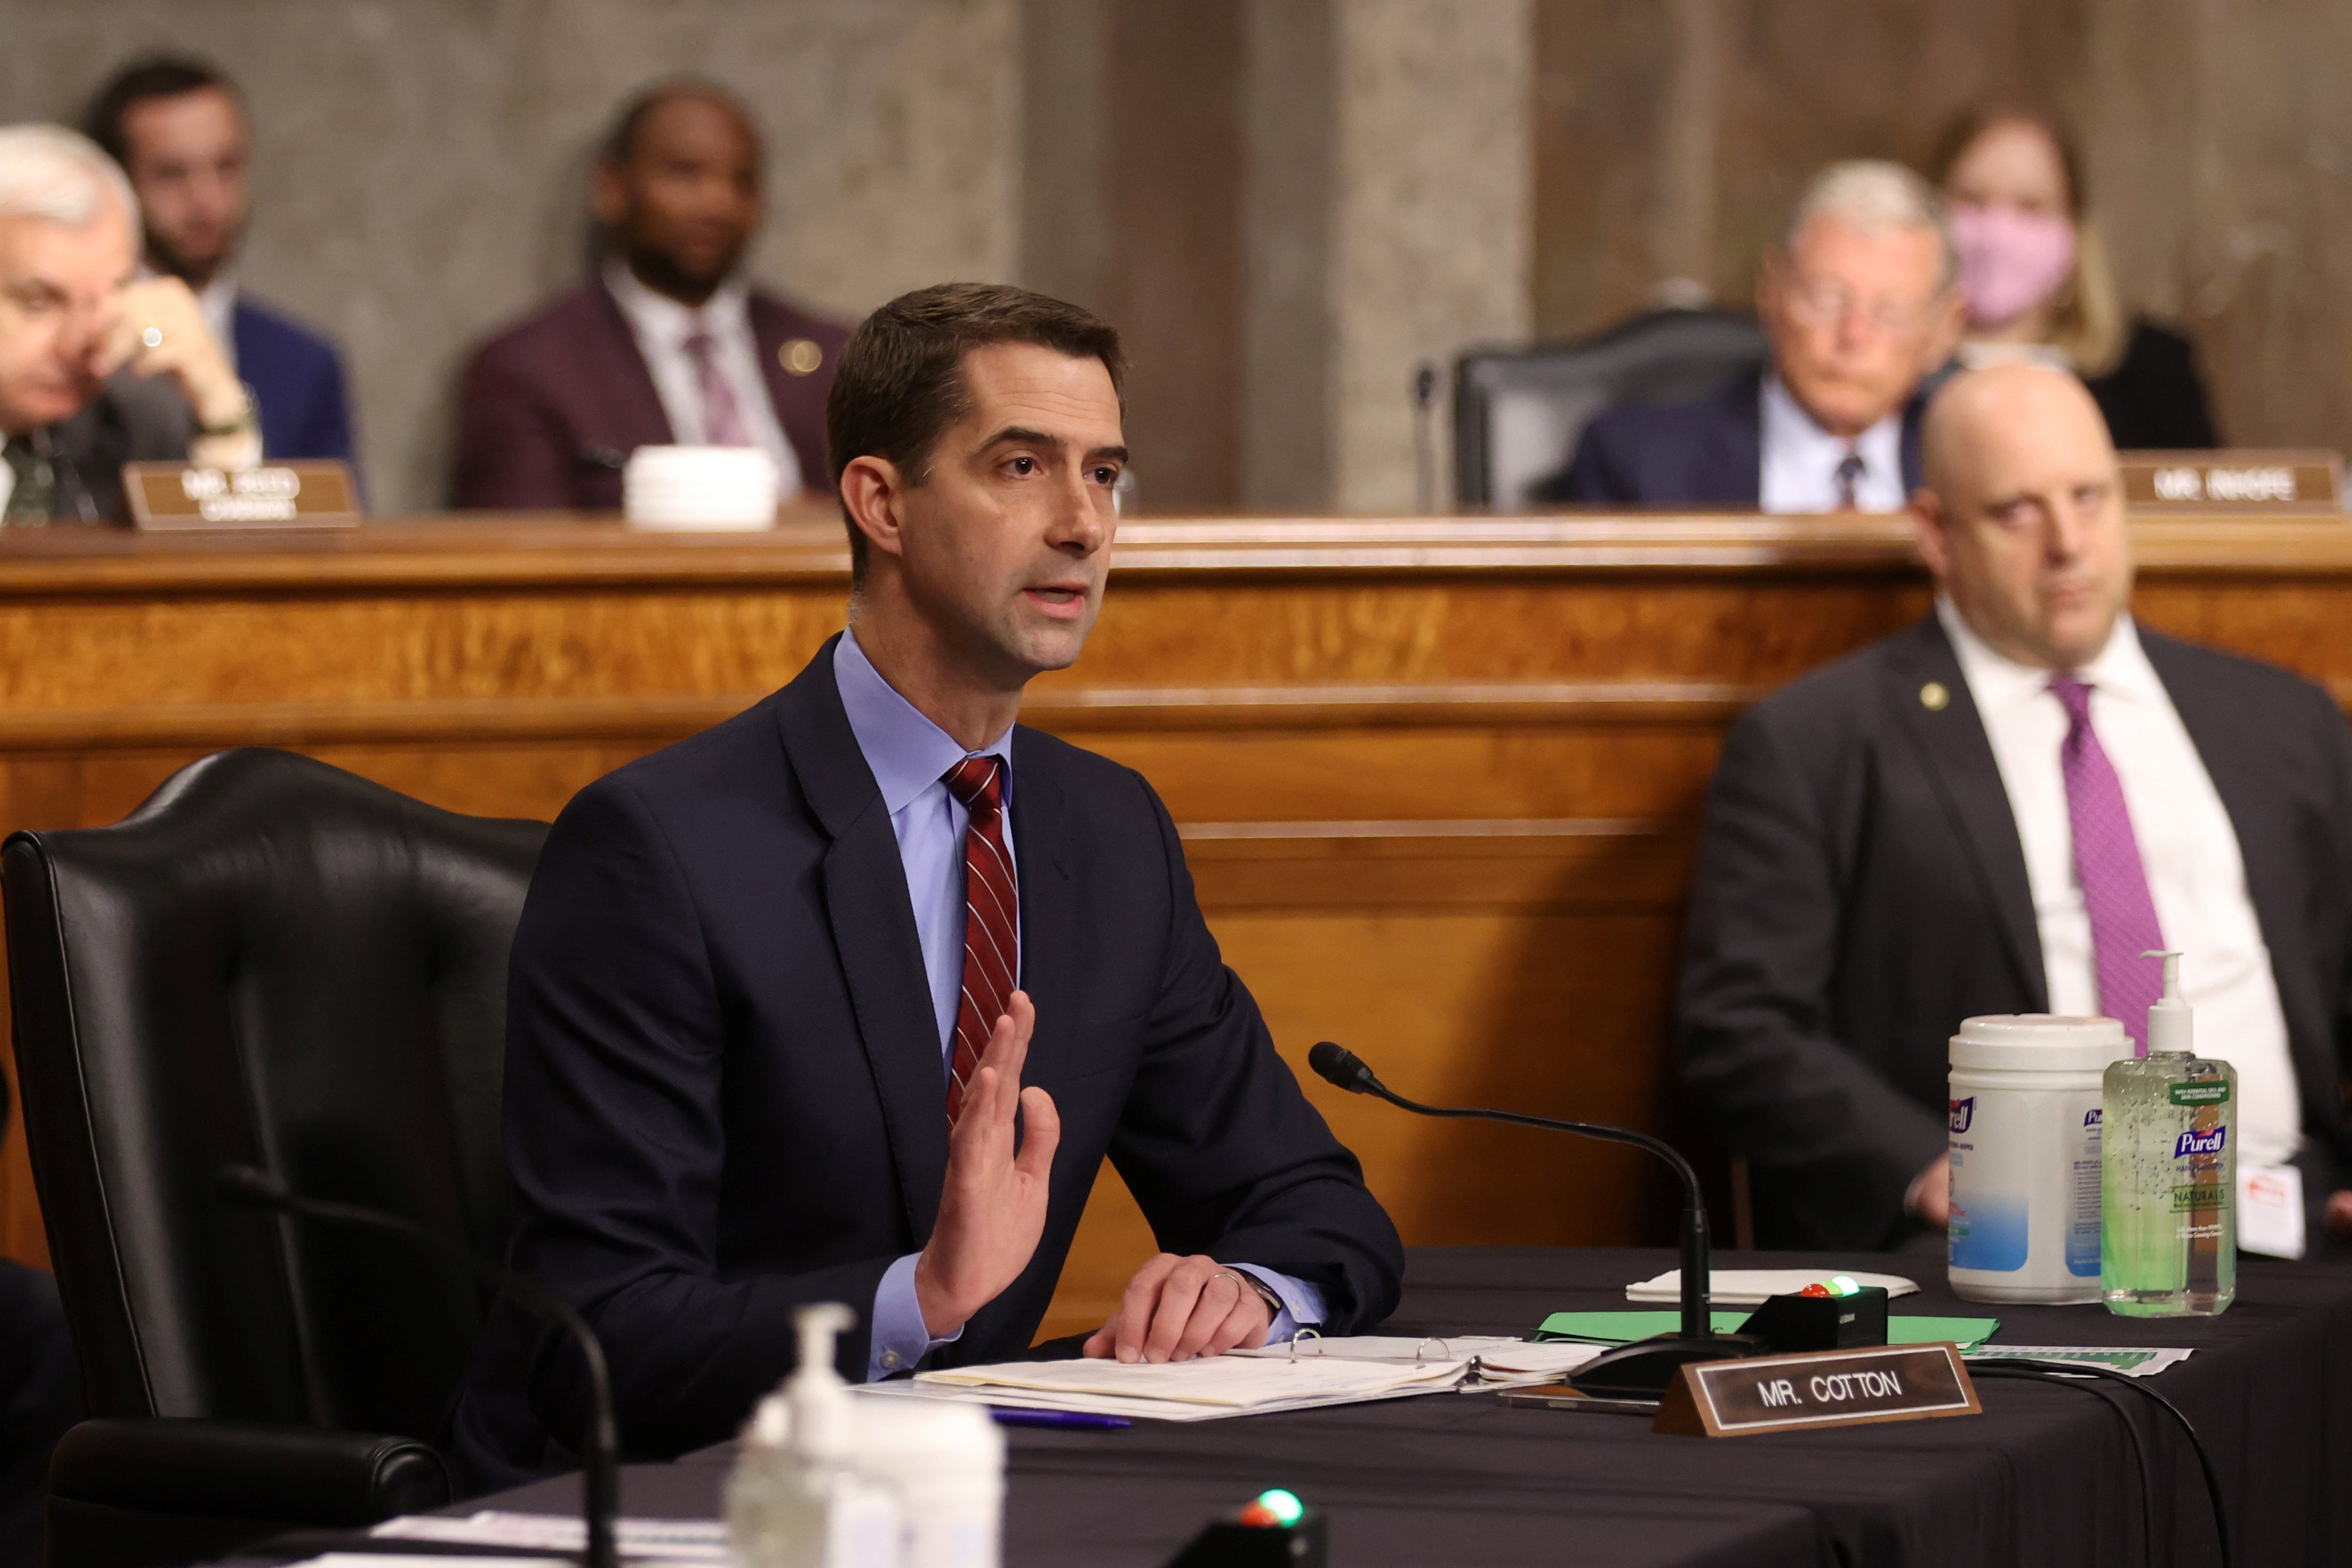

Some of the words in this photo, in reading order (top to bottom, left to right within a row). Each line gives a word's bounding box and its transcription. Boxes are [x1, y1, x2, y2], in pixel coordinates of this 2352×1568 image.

[2181, 1132, 2222, 1153] Purell
[1757, 1379, 1802, 1407] MR.
[1810, 1370, 1902, 1402] COTTON
